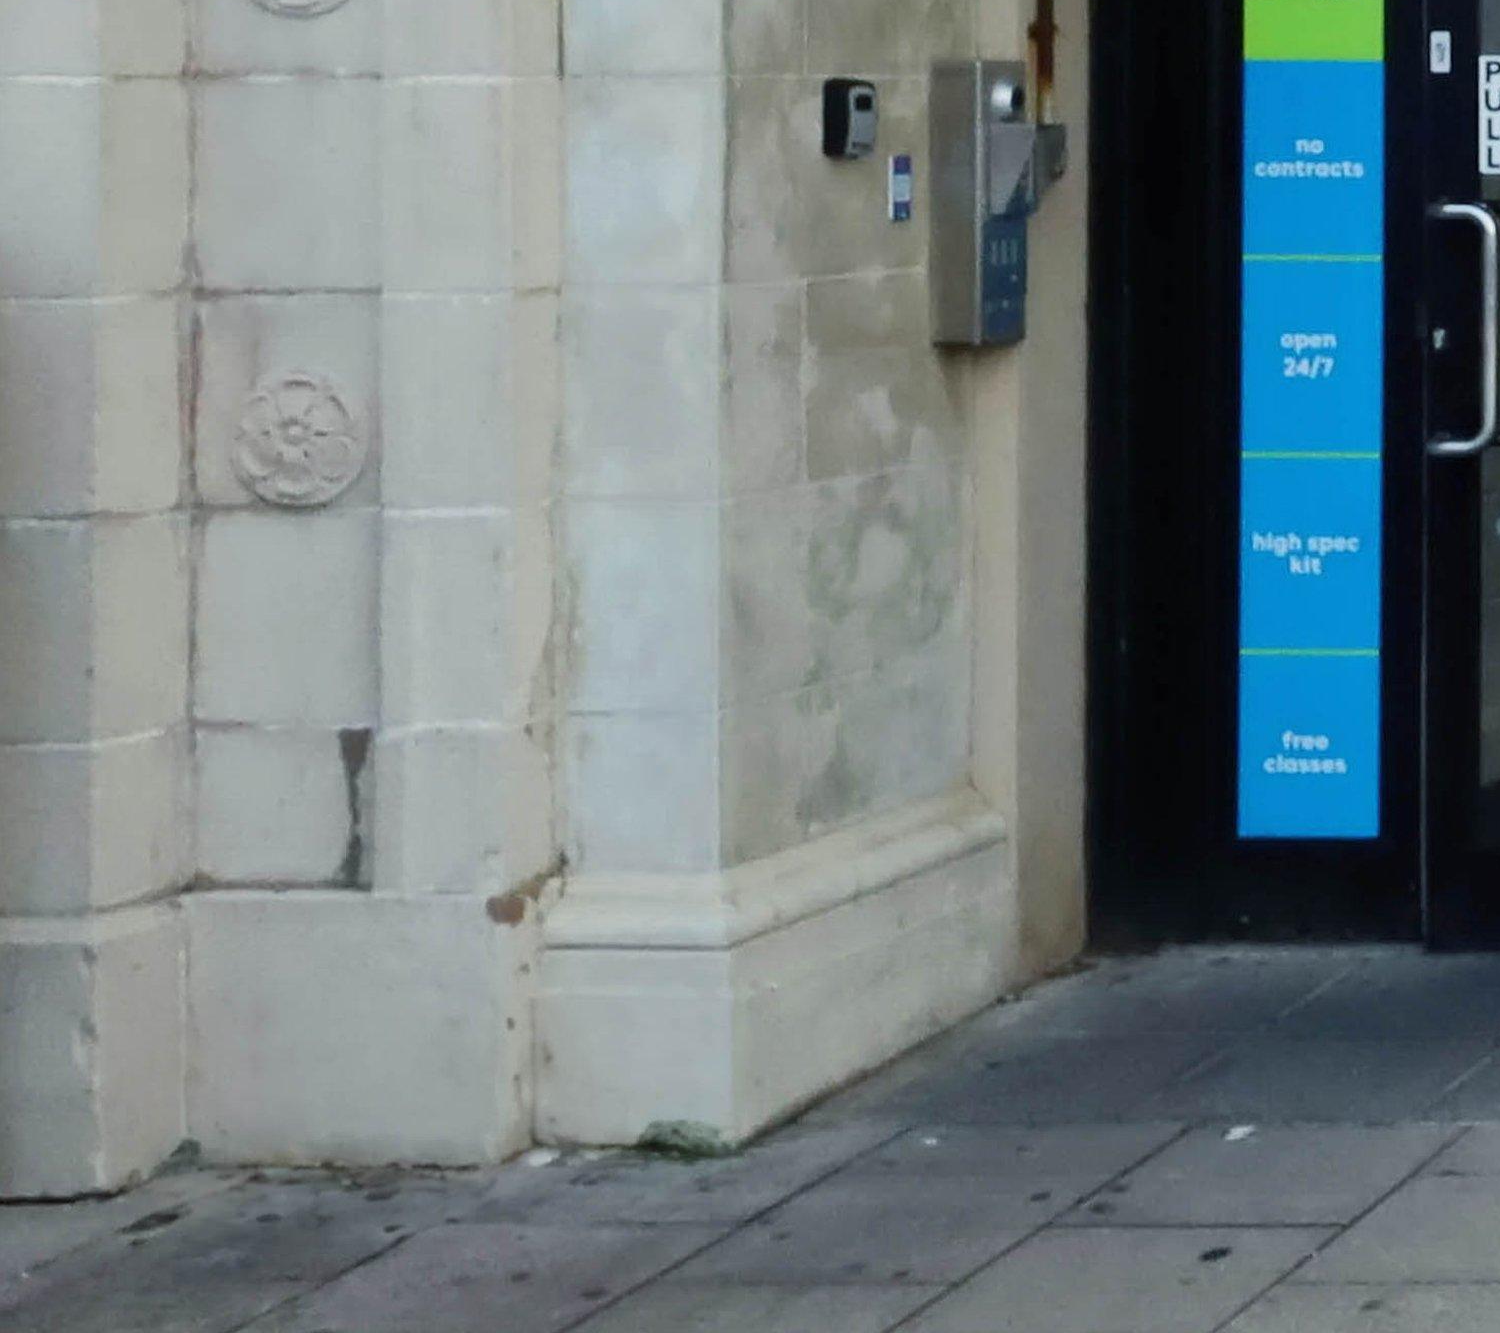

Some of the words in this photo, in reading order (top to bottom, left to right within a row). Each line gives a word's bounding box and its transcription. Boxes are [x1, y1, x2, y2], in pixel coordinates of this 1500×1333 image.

[1294, 138, 1325, 155] no
[1253, 159, 1365, 179] contracts
[1280, 332, 1337, 352] open
[1283, 356, 1335, 378] 24/7
[1252, 532, 1302, 554] high
[1307, 536, 1360, 556] spec
[1289, 555, 1322, 575] kit
[1282, 730, 1330, 750] free
[1263, 754, 1347, 775] classes
